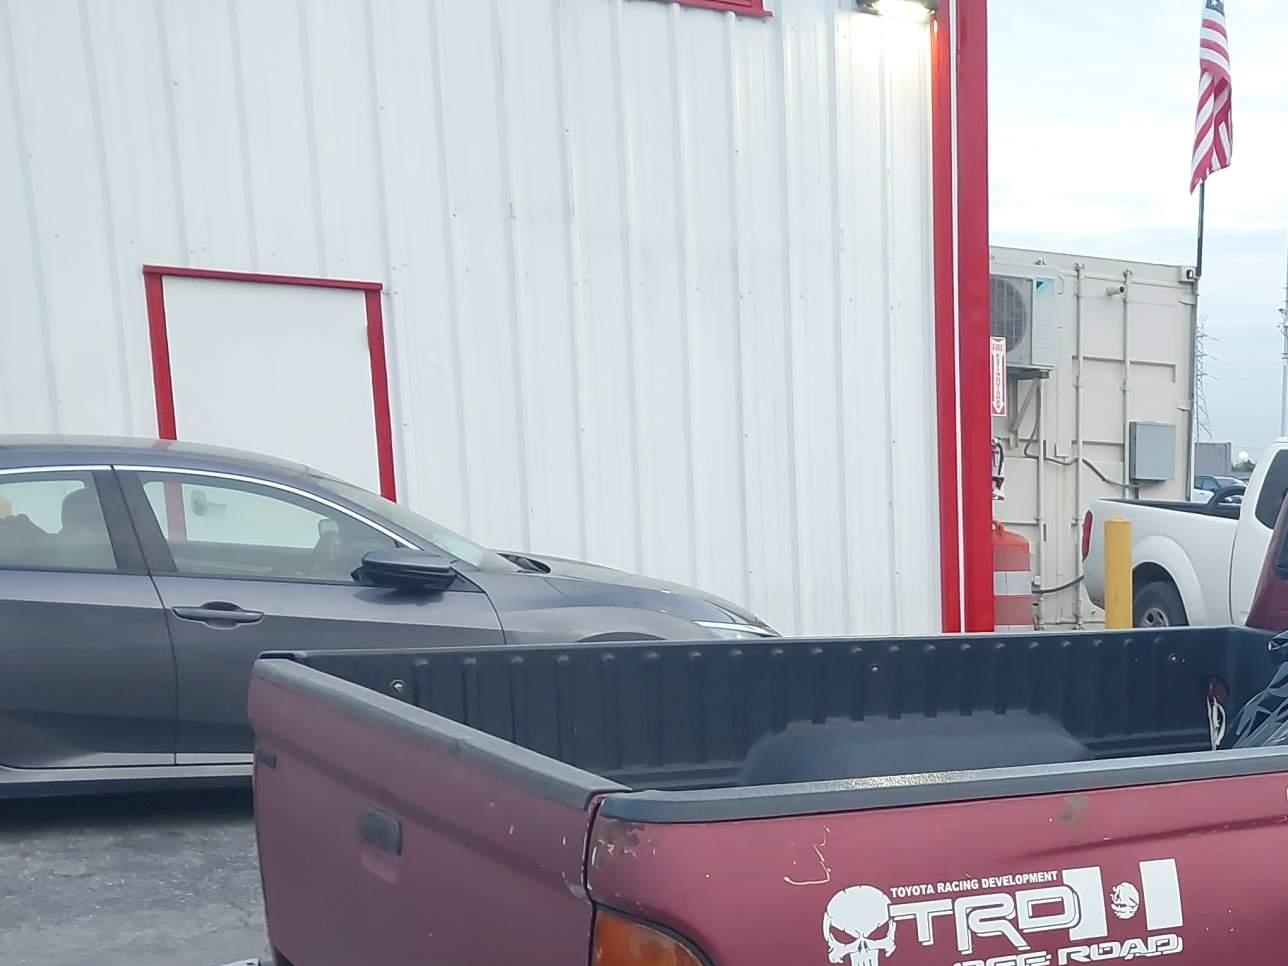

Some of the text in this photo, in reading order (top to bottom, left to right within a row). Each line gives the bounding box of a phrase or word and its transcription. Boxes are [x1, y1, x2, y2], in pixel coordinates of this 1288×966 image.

[890, 870, 1058, 898] TOYOTA RACING DEVELOPMENT
[888, 885, 1082, 955] TRD
[1057, 933, 1184, 966] ROAD
